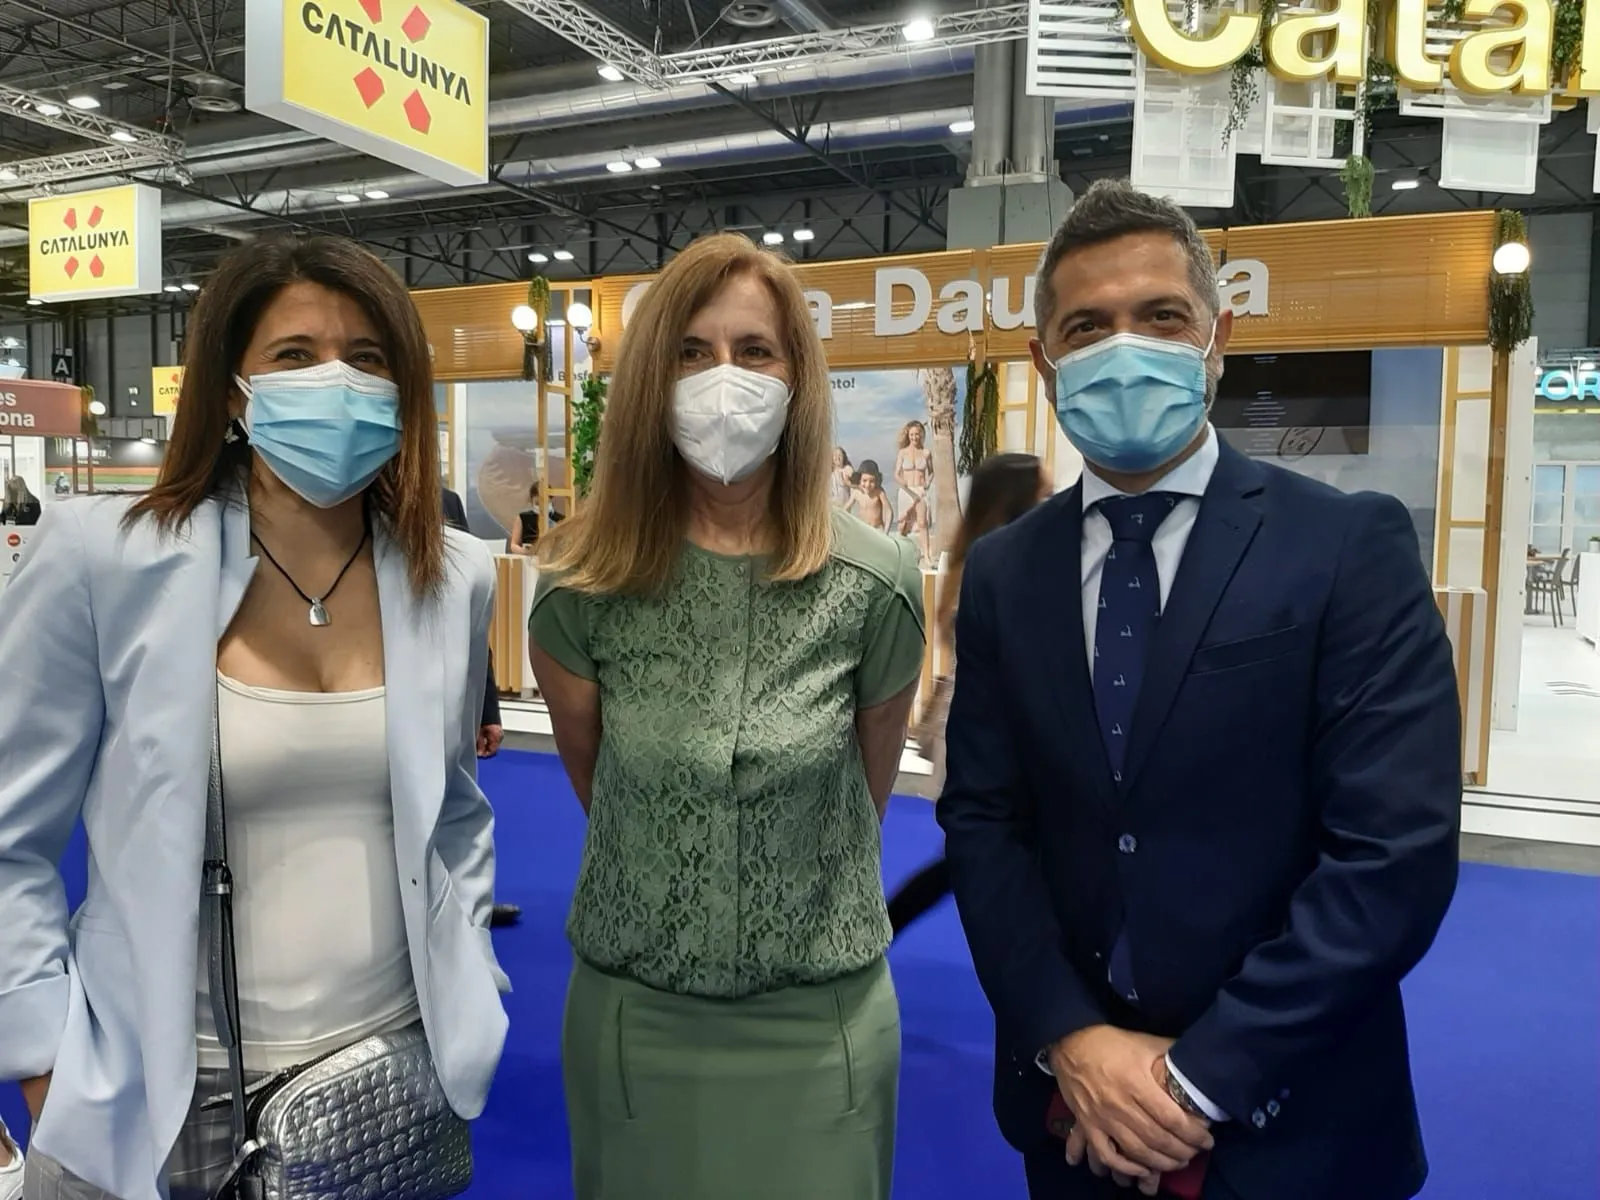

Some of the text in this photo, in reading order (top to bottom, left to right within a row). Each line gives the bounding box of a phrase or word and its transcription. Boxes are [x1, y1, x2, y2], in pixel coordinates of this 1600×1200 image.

[302, 1, 471, 106] CATALUNYA
[40, 230, 129, 255] CATALUNYA
[874, 258, 1270, 338] Daua
[55, 358, 69, 375] A
